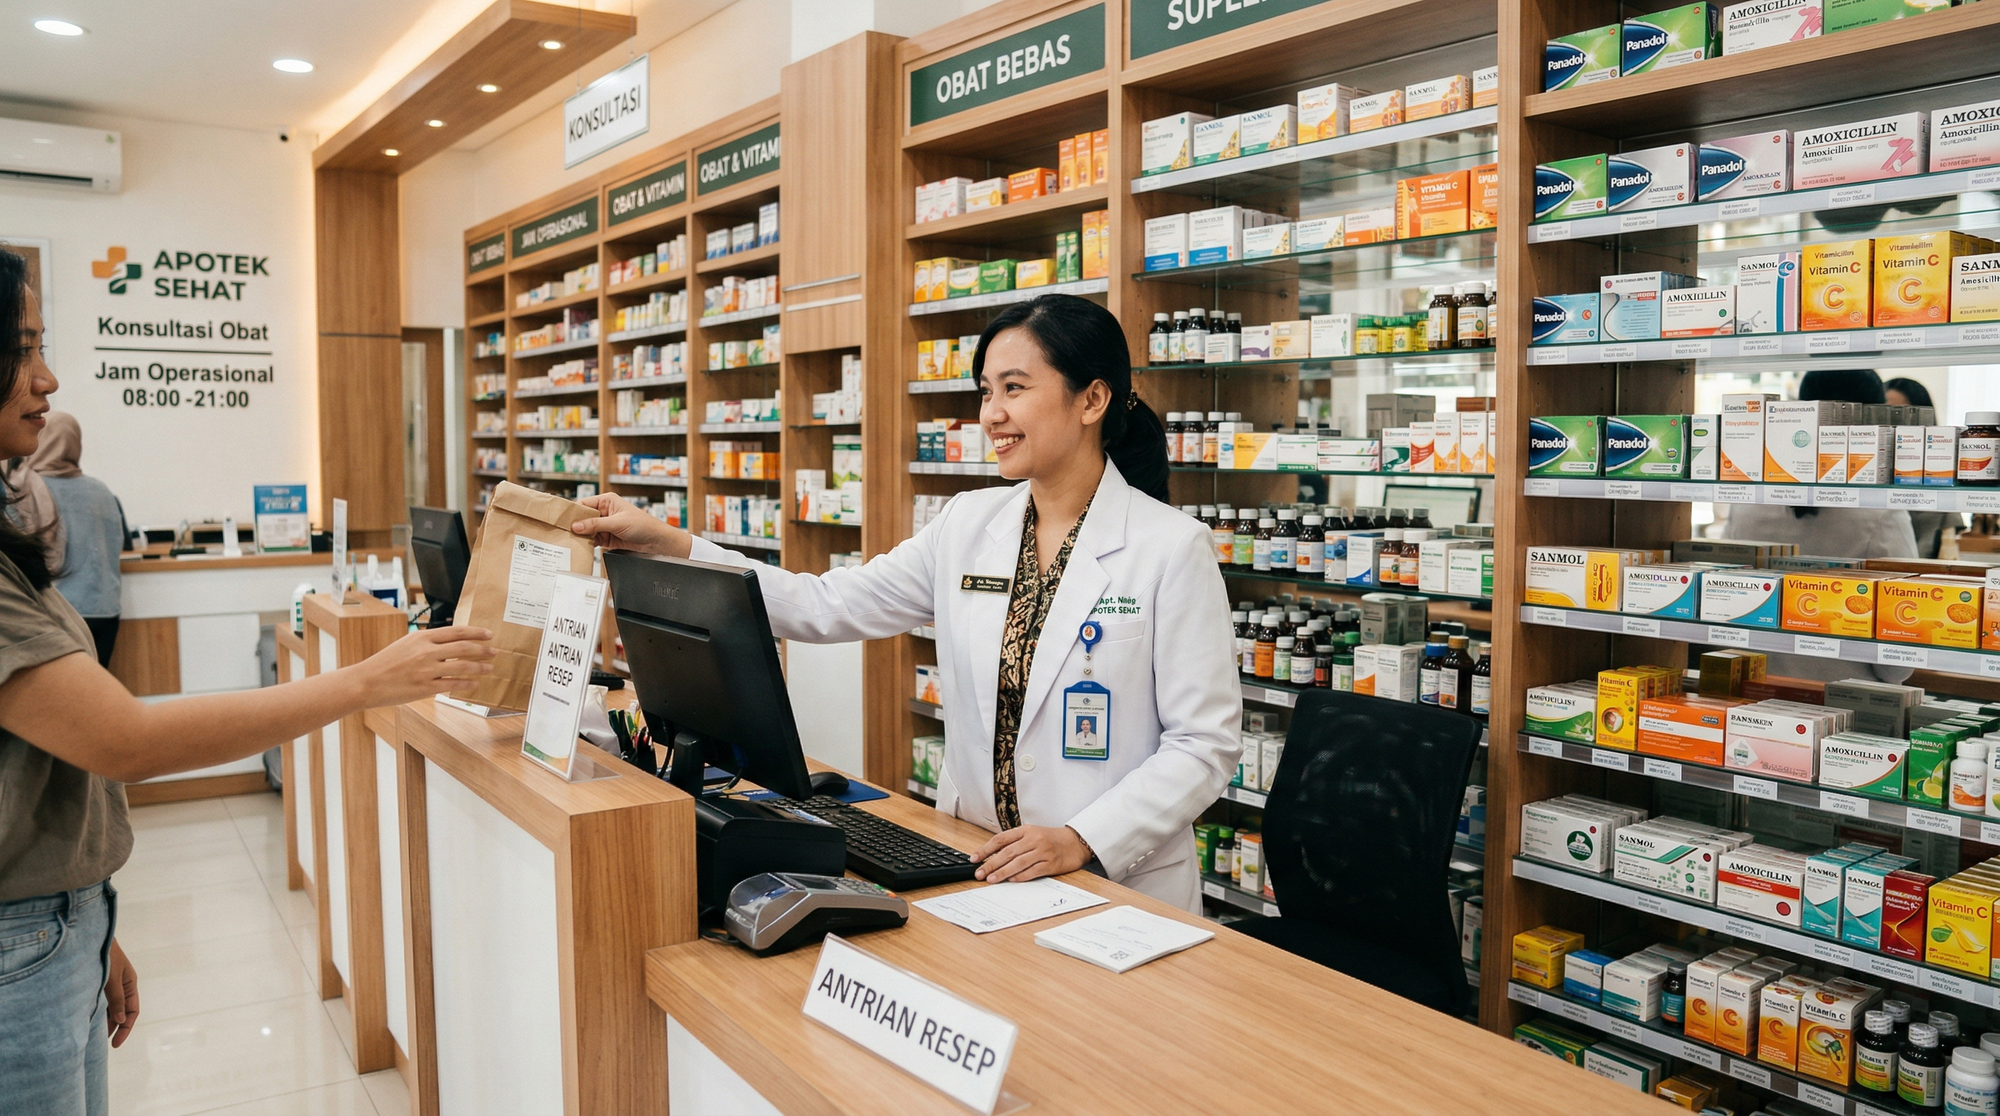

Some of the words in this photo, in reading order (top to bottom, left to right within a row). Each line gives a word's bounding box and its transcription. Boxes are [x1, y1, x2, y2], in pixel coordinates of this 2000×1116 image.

[1626, 33, 1665, 51] Panadol
[936, 60, 991, 104] OBAT
[996, 34, 1072, 84] BEBAS
[1548, 53, 1583, 71] Panadol
[569, 85, 642, 143] KONSULTASI
[1802, 122, 1898, 146] AMOXICILLIN
[1802, 145, 1853, 159] Amoxicillin
[700, 155, 730, 184] OBAT
[731, 152, 740, 173] &
[1701, 160, 1743, 176] Panadol
[1537, 180, 1572, 195] Panadol
[1611, 172, 1650, 188] Panadol
[613, 190, 637, 216] OBAT
[645, 172, 685, 204] VITAMIN
[154, 251, 270, 276] APOTEK
[1741, 262, 1777, 271] SANMOL
[1809, 265, 1848, 276] Vitamin
[1850, 261, 1861, 273] C
[1883, 257, 1926, 269] Vitamin
[1928, 254, 1940, 266] C
[154, 278, 247, 301] SEHAT
[98, 317, 213, 339] Konsultasi
[220, 322, 269, 341] Obat
[95, 362, 140, 381] Jam
[147, 363, 274, 386] Operasional
[123, 389, 180, 406] 08:00
[1531, 438, 1566, 449] Panadol
[1608, 438, 1647, 449] Panadol
[1531, 552, 1584, 565] SANMOL
[1788, 579, 1828, 592] Vitamin
[1831, 581, 1843, 594] C
[1884, 585, 1928, 599] Vitamin
[1930, 587, 1944, 601] C
[553, 616, 588, 640] ANTRIAN
[548, 641, 583, 667] ANTRIAN
[548, 665, 573, 688] RESEP
[1825, 746, 1883, 760] AMOXICILLIN
[1619, 834, 1656, 850] SANMOL
[1729, 862, 1793, 883] AMOXICILLIN
[1976, 906, 1988, 919] C
[817, 968, 917, 1038] ANTRIAN
[920, 1018, 997, 1076] RESEP
[1839, 1013, 1846, 1021] C
